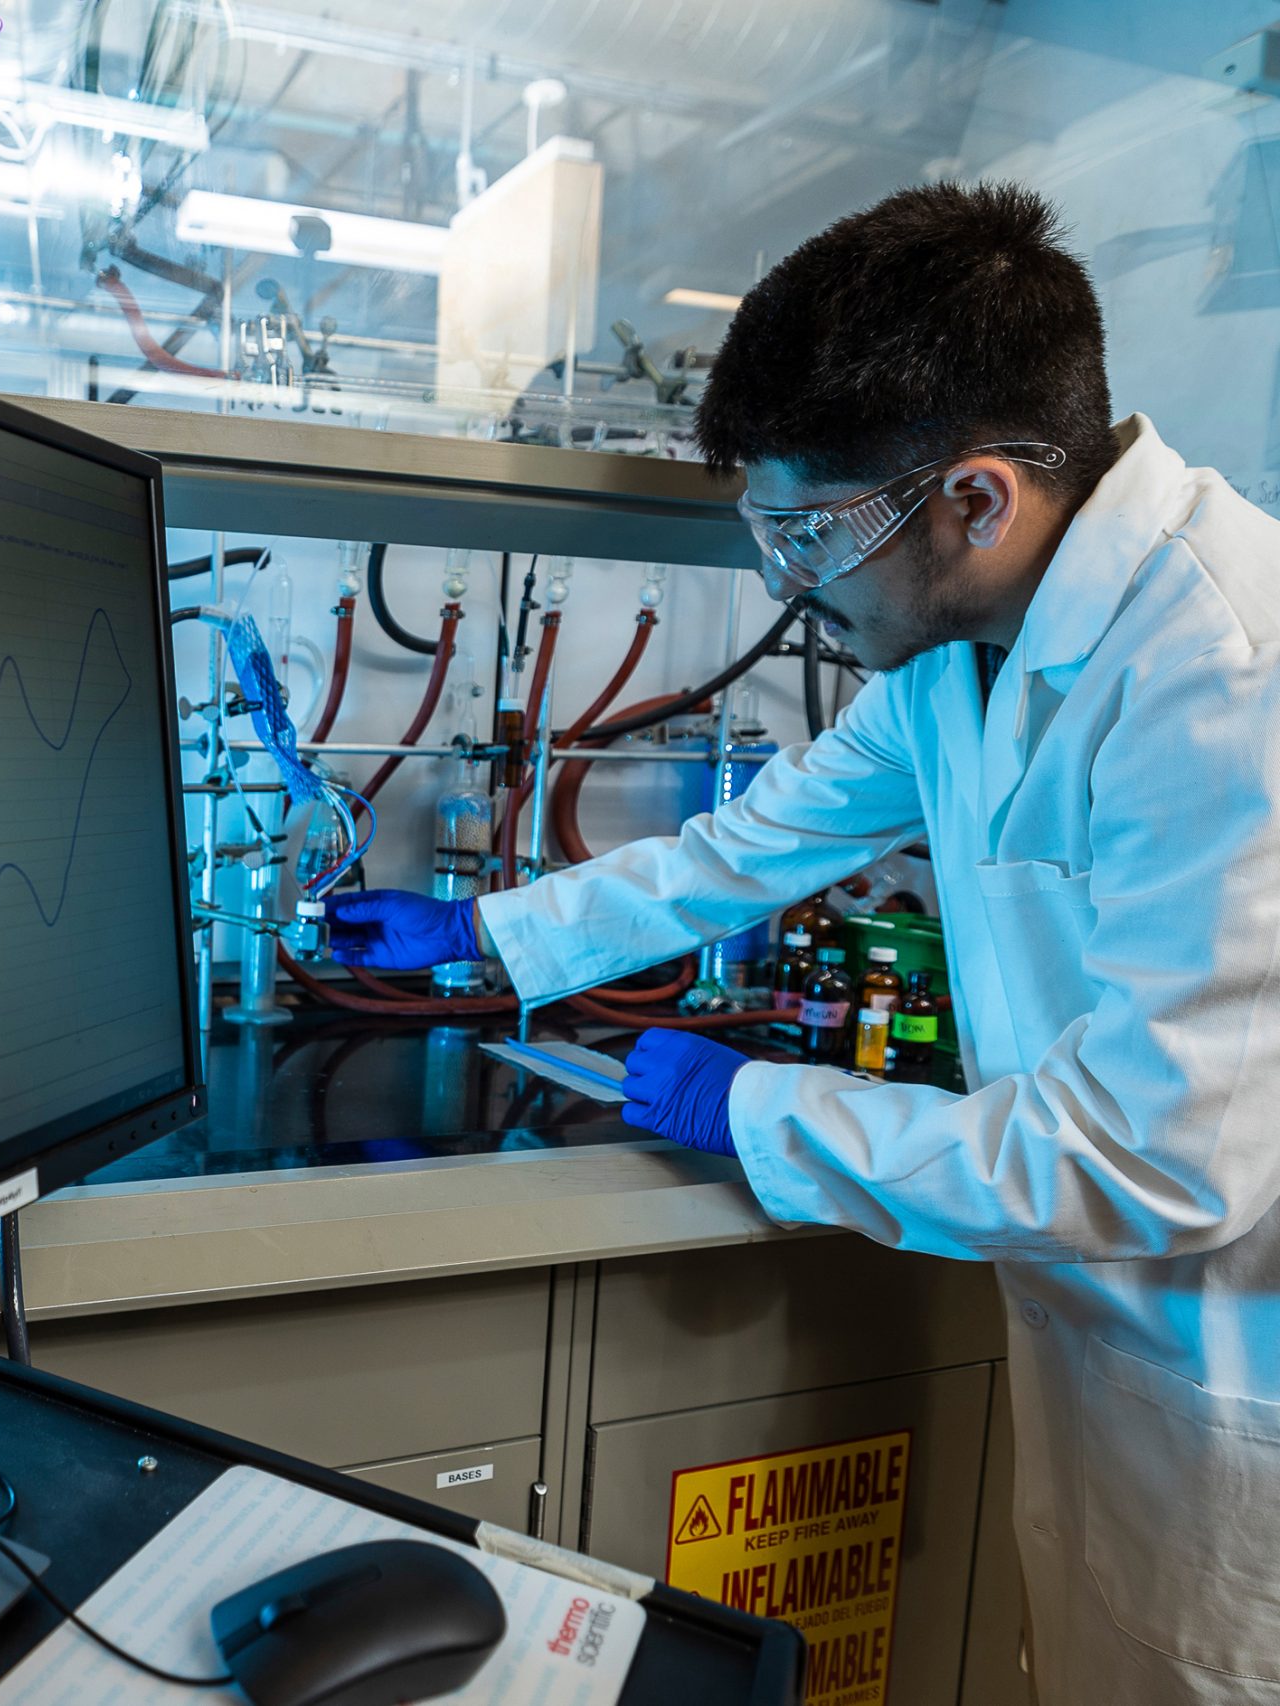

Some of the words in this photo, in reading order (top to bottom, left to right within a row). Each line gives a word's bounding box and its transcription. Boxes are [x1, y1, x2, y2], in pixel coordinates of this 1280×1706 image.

[448, 1469, 482, 1483] BASES
[727, 1446, 904, 1535] FLAMMABLE
[744, 1531, 789, 1552] KEEP
[793, 1520, 831, 1542] FIRE
[835, 1510, 880, 1533] AWAY
[721, 1536, 895, 1618] INFLAMABLE
[547, 1596, 591, 1657] thermo
[576, 1601, 617, 1668] scientific
[832, 1606, 851, 1621] DEL
[805, 1626, 886, 1699] MABLE
